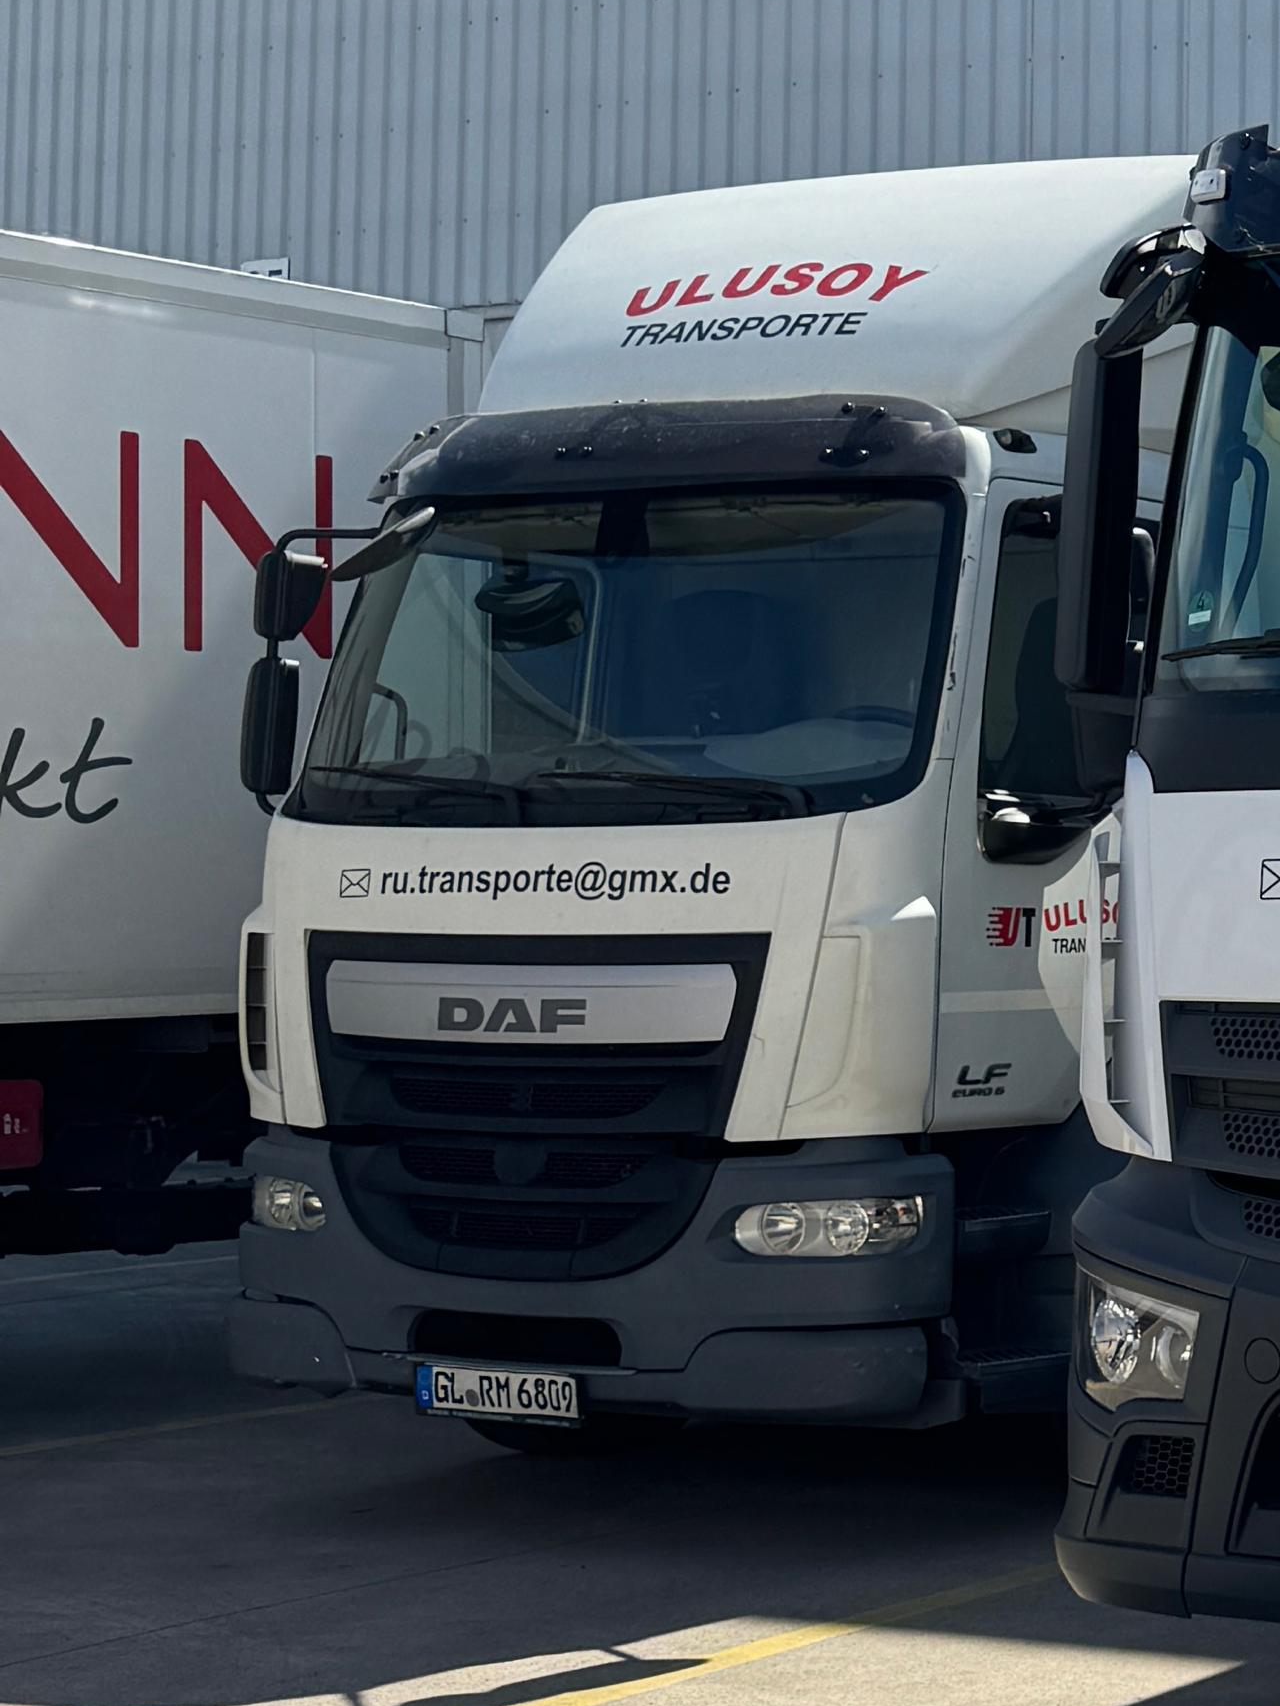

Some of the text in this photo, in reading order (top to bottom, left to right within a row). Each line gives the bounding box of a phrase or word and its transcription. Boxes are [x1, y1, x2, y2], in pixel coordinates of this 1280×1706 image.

[625, 262, 931, 318] ULUSOY
[620, 311, 868, 348] TRANSPORTE
[380, 861, 732, 901] ru.transporte@gmx.de
[437, 997, 587, 1033] DAF
[957, 1063, 1012, 1085] LF
[434, 1371, 573, 1413] GL RM 6809
